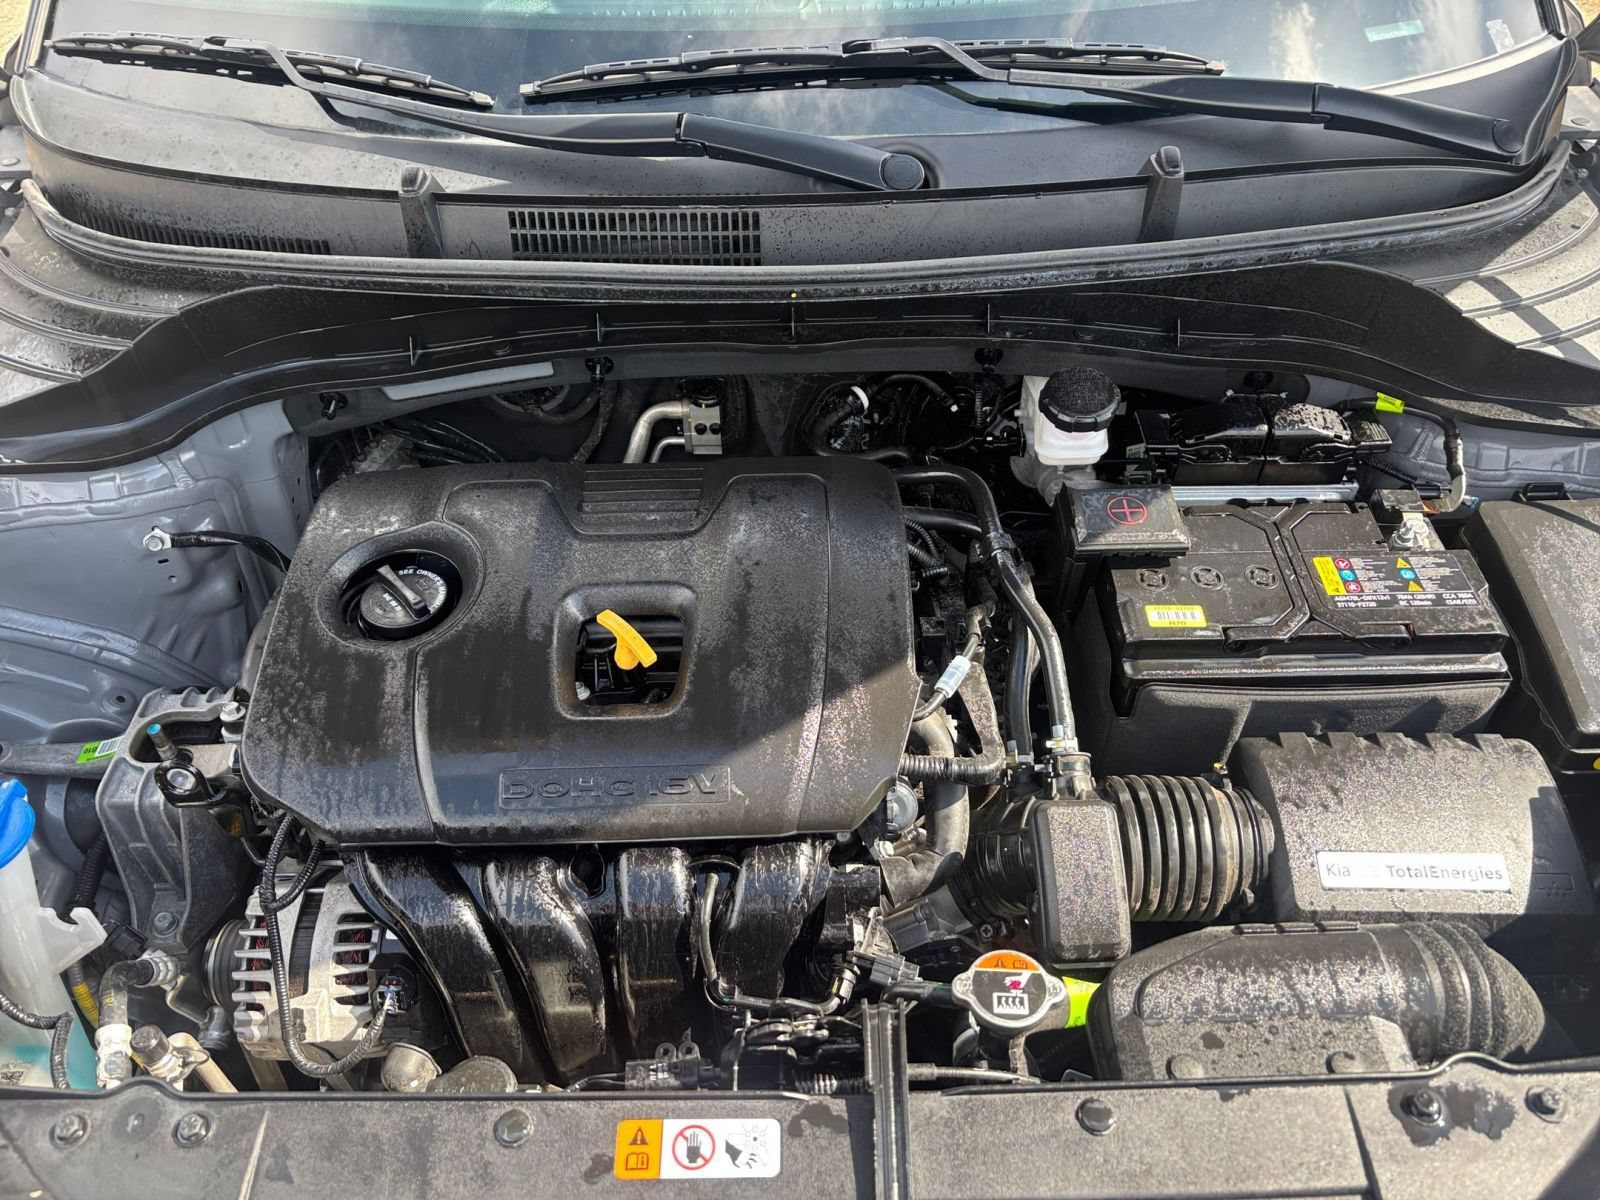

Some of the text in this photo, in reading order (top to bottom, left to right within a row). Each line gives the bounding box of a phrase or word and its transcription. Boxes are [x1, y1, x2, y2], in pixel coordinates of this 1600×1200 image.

[398, 568, 414, 576] SEE
[502, 775, 636, 800] DOHC
[1325, 863, 1351, 878] Kia
[1385, 864, 1503, 882] TotalEnergies
